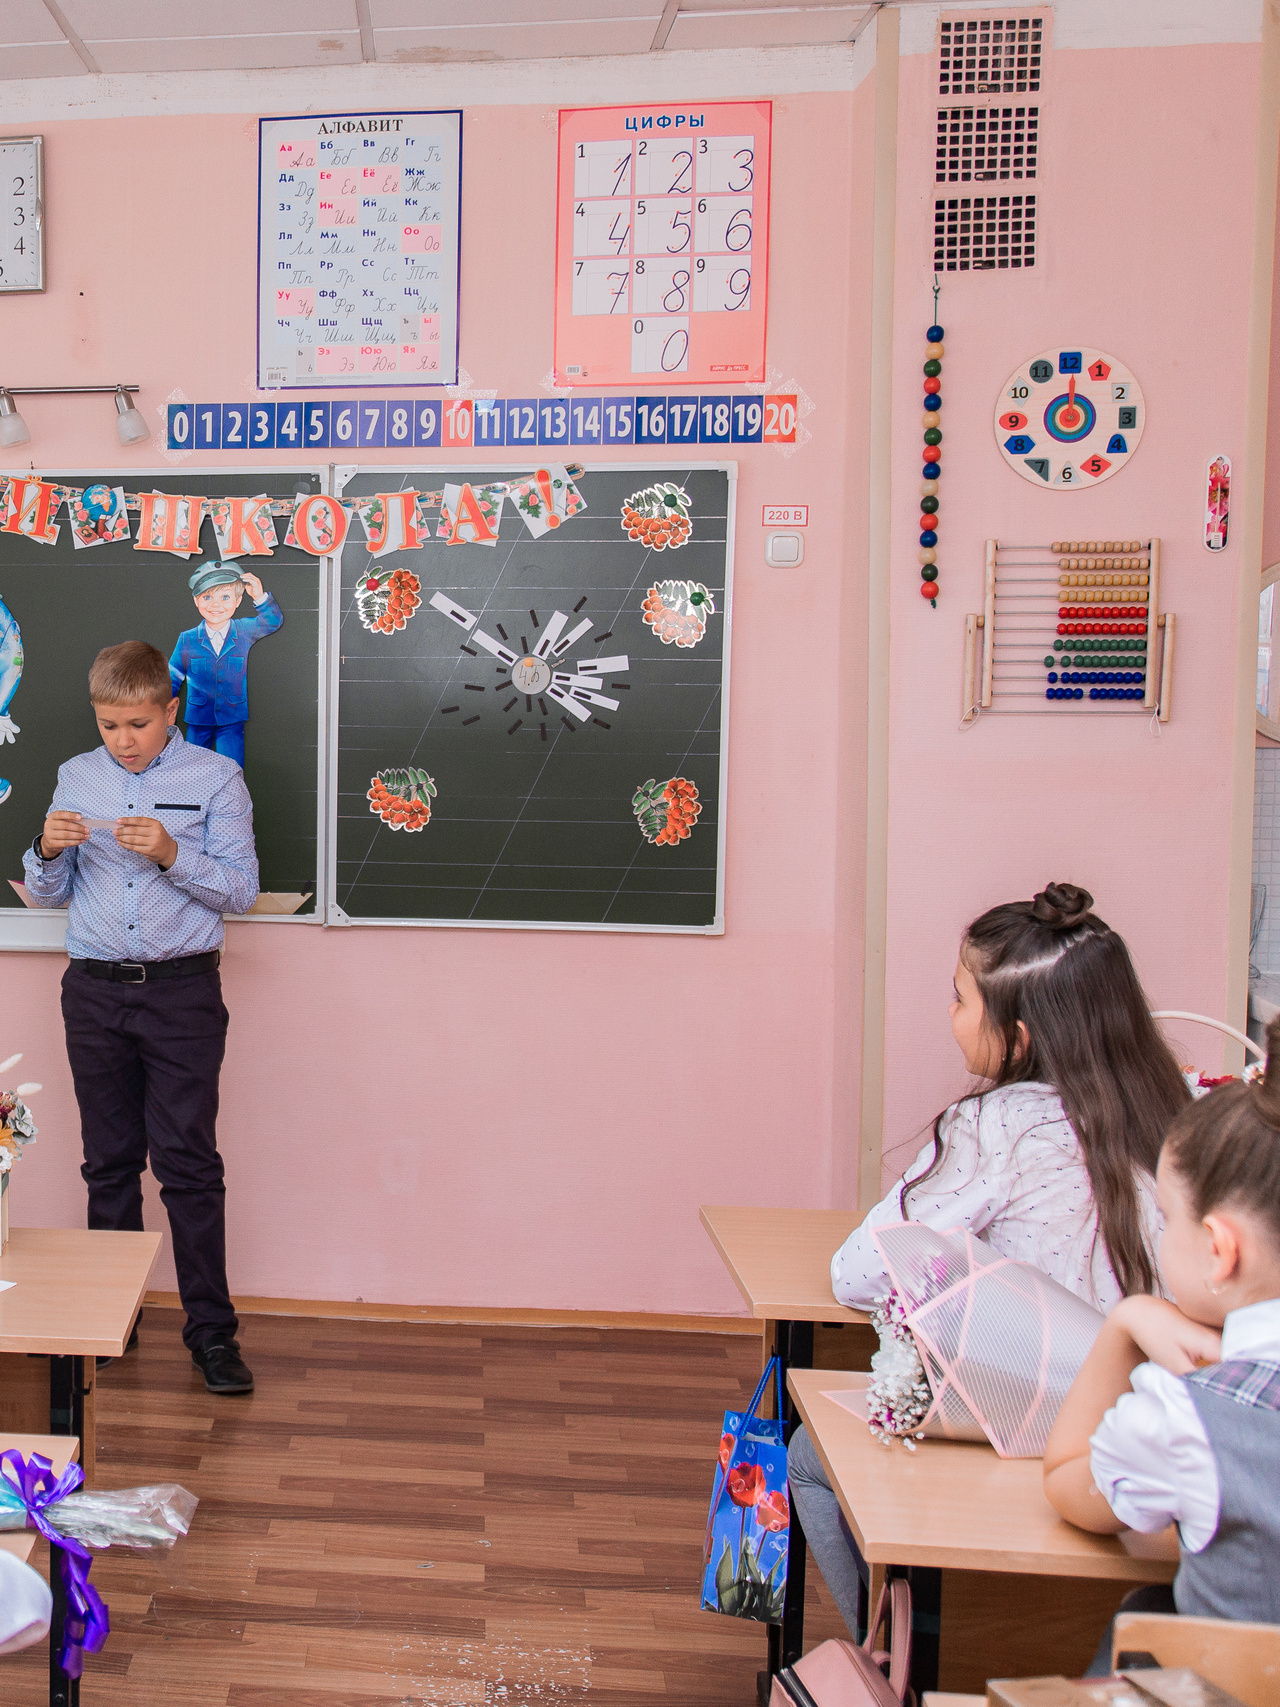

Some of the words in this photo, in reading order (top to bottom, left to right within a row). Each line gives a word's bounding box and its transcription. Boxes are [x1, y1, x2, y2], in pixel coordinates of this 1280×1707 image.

[317, 119, 404, 135] АЛФАВИТ
[625, 114, 705, 131] ЦИФРЫ
[578, 144, 585, 158] 1
[639, 141, 647, 156] 2
[699, 139, 708, 154] 3
[612, 153, 632, 196] 1
[668, 151, 693, 194] 2
[728, 149, 754, 192] 3
[12, 176, 25, 196] 2
[576, 203, 585, 216] 4
[637, 201, 646, 215] 5
[698, 199, 706, 213] 6
[13, 207, 25, 226] 3
[608, 212, 630, 255] 4
[666, 210, 692, 253] 5
[726, 209, 752, 251] 6
[13, 236, 26, 255] 4
[575, 262, 584, 276] 7
[635, 260, 645, 274] 8
[696, 258, 705, 273] 9
[607, 271, 629, 314] 7
[663, 270, 690, 312] 8
[724, 268, 751, 311] 9
[634, 320, 644, 334] 0
[661, 329, 689, 372] 0
[1061, 357, 1079, 370] 12
[1095, 365, 1104, 377] 1
[1032, 366, 1050, 378] 11
[1011, 386, 1028, 399] 10
[1115, 387, 1125, 399] 2
[173, 412, 189, 442] 0
[201, 411, 213, 442] 1
[227, 411, 242, 442] 2
[254, 411, 269, 442] 3
[281, 410, 298, 441] 4
[309, 409, 324, 441] 5
[336, 409, 352, 441] 6
[365, 409, 380, 440] 7
[392, 408, 408, 440] 8
[420, 408, 436, 440] 9
[446, 408, 470, 439] 10
[478, 406, 500, 439] 11
[509, 405, 535, 439] 12
[541, 405, 566, 438] 13
[573, 404, 600, 438] 14
[606, 404, 631, 437] 15
[638, 404, 665, 437] 16
[670, 404, 696, 437] 17
[702, 404, 729, 436] 18
[734, 403, 761, 436] 19
[765, 403, 795, 435] 20
[1009, 415, 1019, 428] 9
[1122, 412, 1132, 424] 3
[1014, 439, 1025, 451] 8
[1111, 438, 1122, 450] 4
[1035, 461, 1045, 474] 7
[1091, 460, 1101, 472] 5
[1062, 467, 1072, 482] 6
[768, 510, 790, 521] 220
